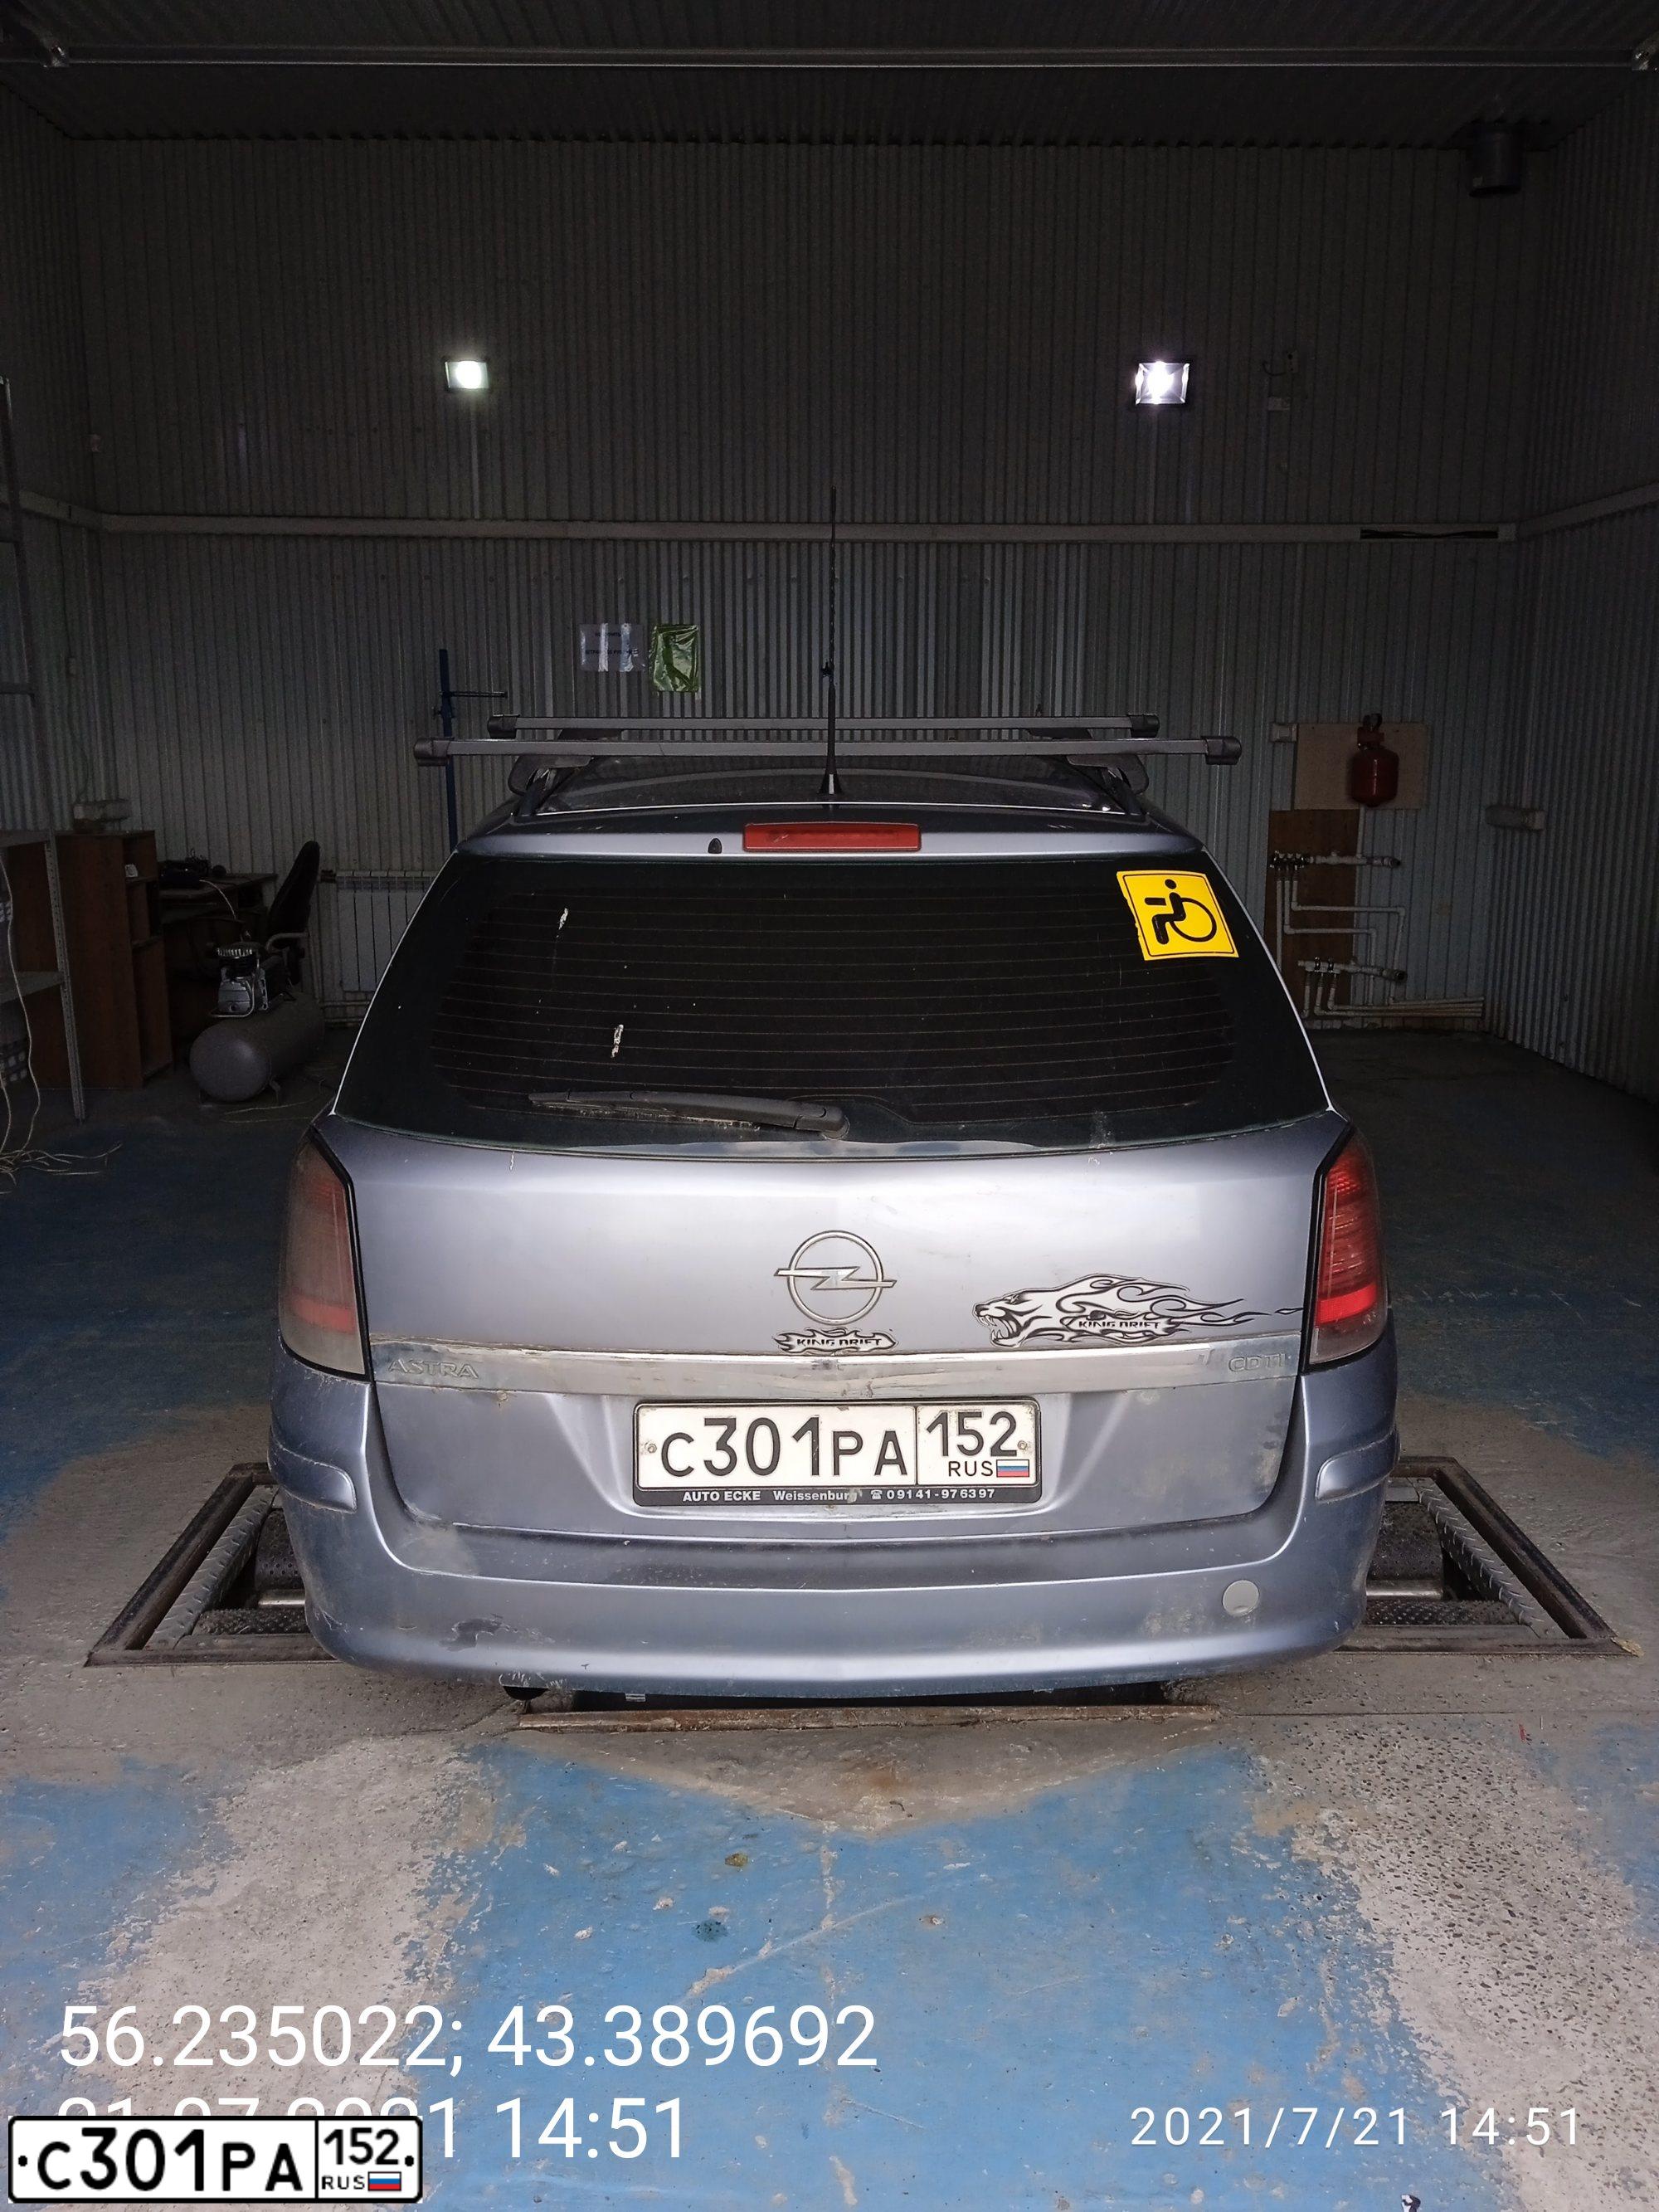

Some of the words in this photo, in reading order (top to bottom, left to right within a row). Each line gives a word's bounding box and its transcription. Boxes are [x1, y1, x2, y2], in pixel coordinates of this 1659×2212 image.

[1078, 1320, 1116, 1328] KING
[1120, 1320, 1160, 1329] DRIFT
[796, 1337, 835, 1347] KING
[839, 1337, 883, 1347] DRIFT
[387, 1357, 479, 1380] ASTRA
[1228, 1352, 1286, 1373] CDTI
[926, 1411, 1019, 1457] 152
[948, 1460, 994, 1477] RUS
[682, 1490, 720, 1503] AUTO
[724, 1490, 761, 1502] ECKE
[772, 1490, 854, 1503] Weissenbur
